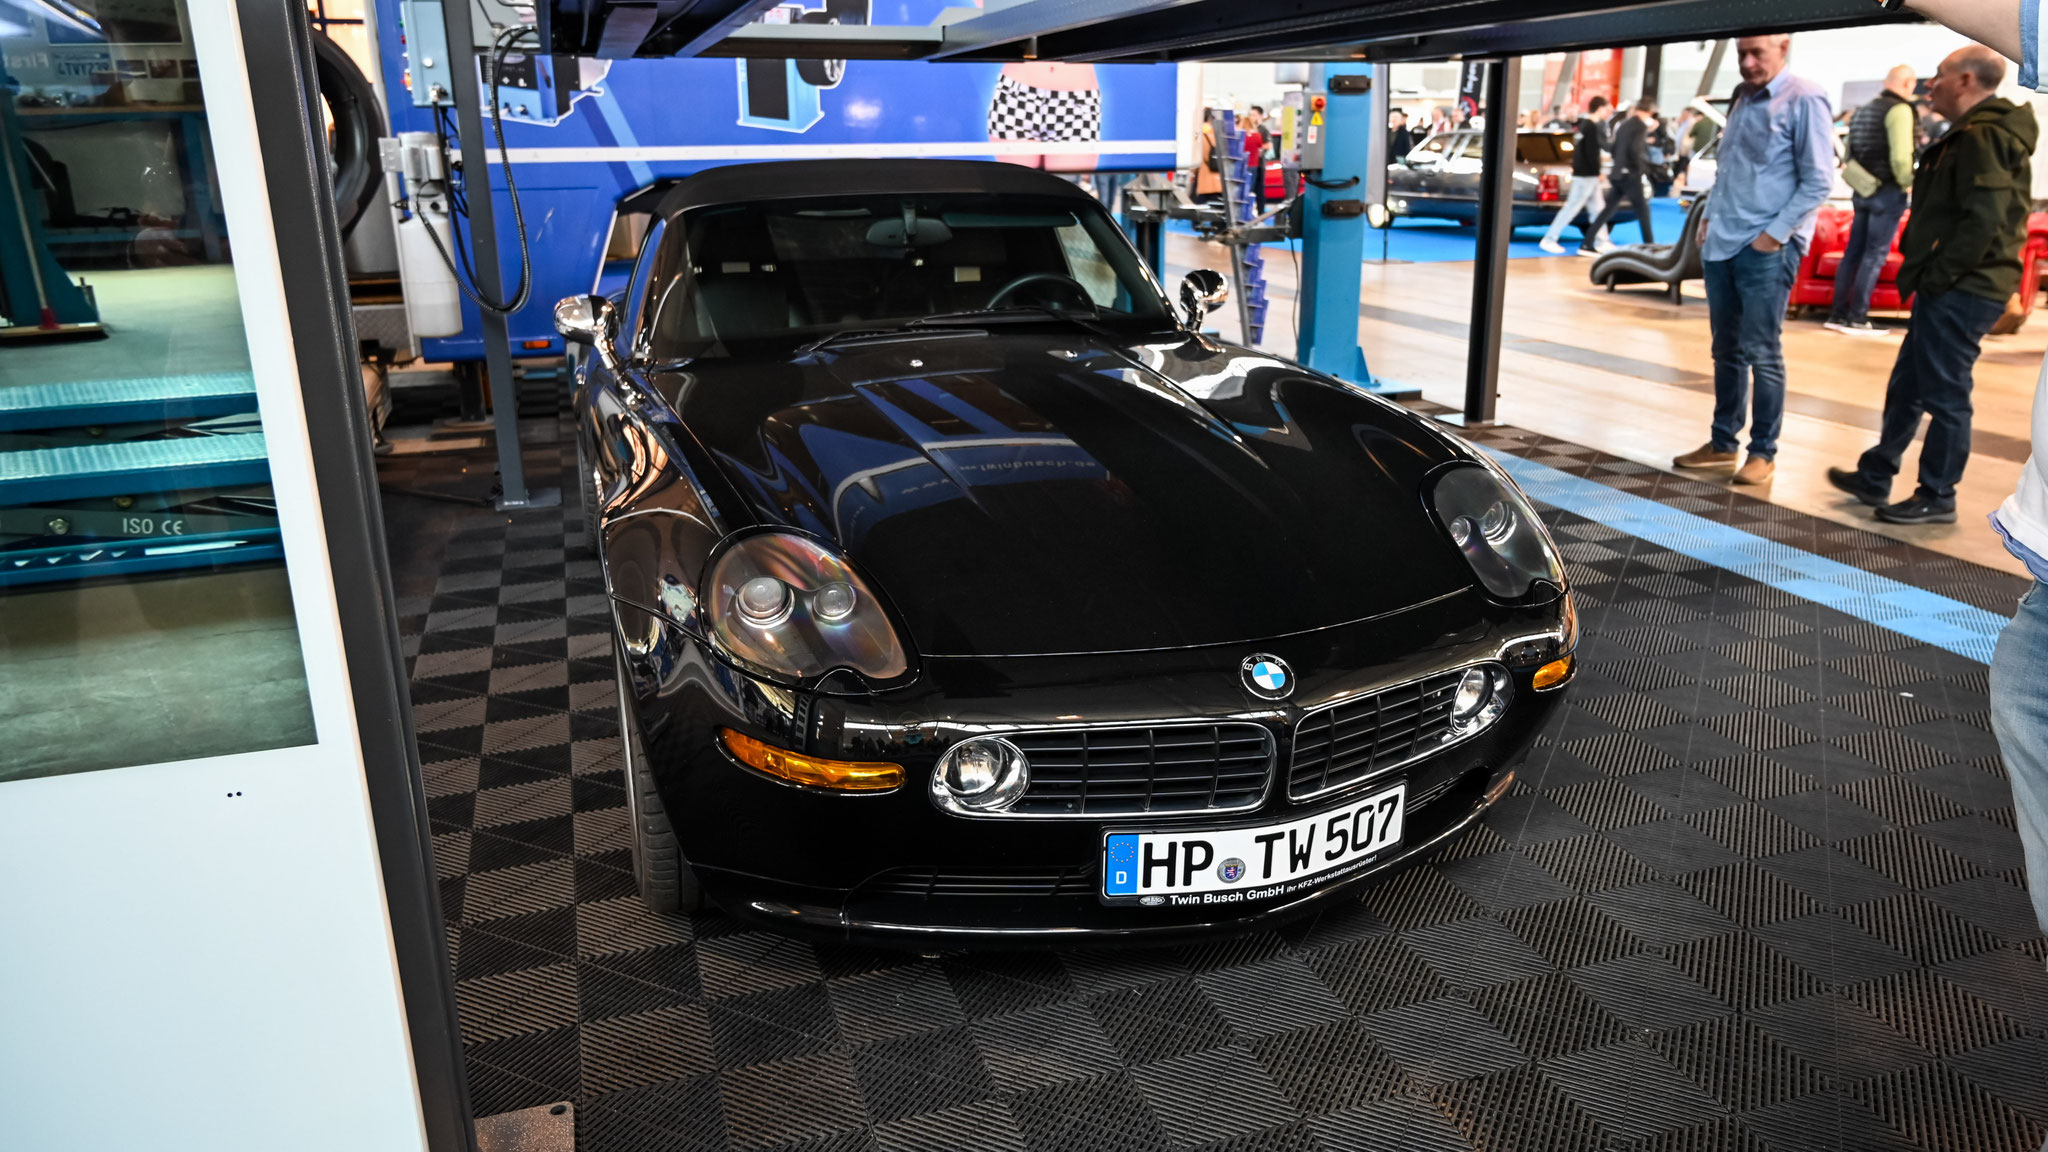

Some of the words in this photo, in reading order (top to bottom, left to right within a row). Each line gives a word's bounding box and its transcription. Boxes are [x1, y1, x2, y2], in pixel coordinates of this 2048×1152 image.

[122, 517, 154, 535] ISO
[1243, 655, 1284, 671] BMW
[1142, 840, 1214, 889] HP
[1255, 823, 1317, 879] TW
[1325, 793, 1399, 861] 507
[1116, 871, 1127, 884] D
[1170, 894, 1200, 905] Twin
[1203, 891, 1243, 904] Busch
[1246, 885, 1285, 900] GmbH
